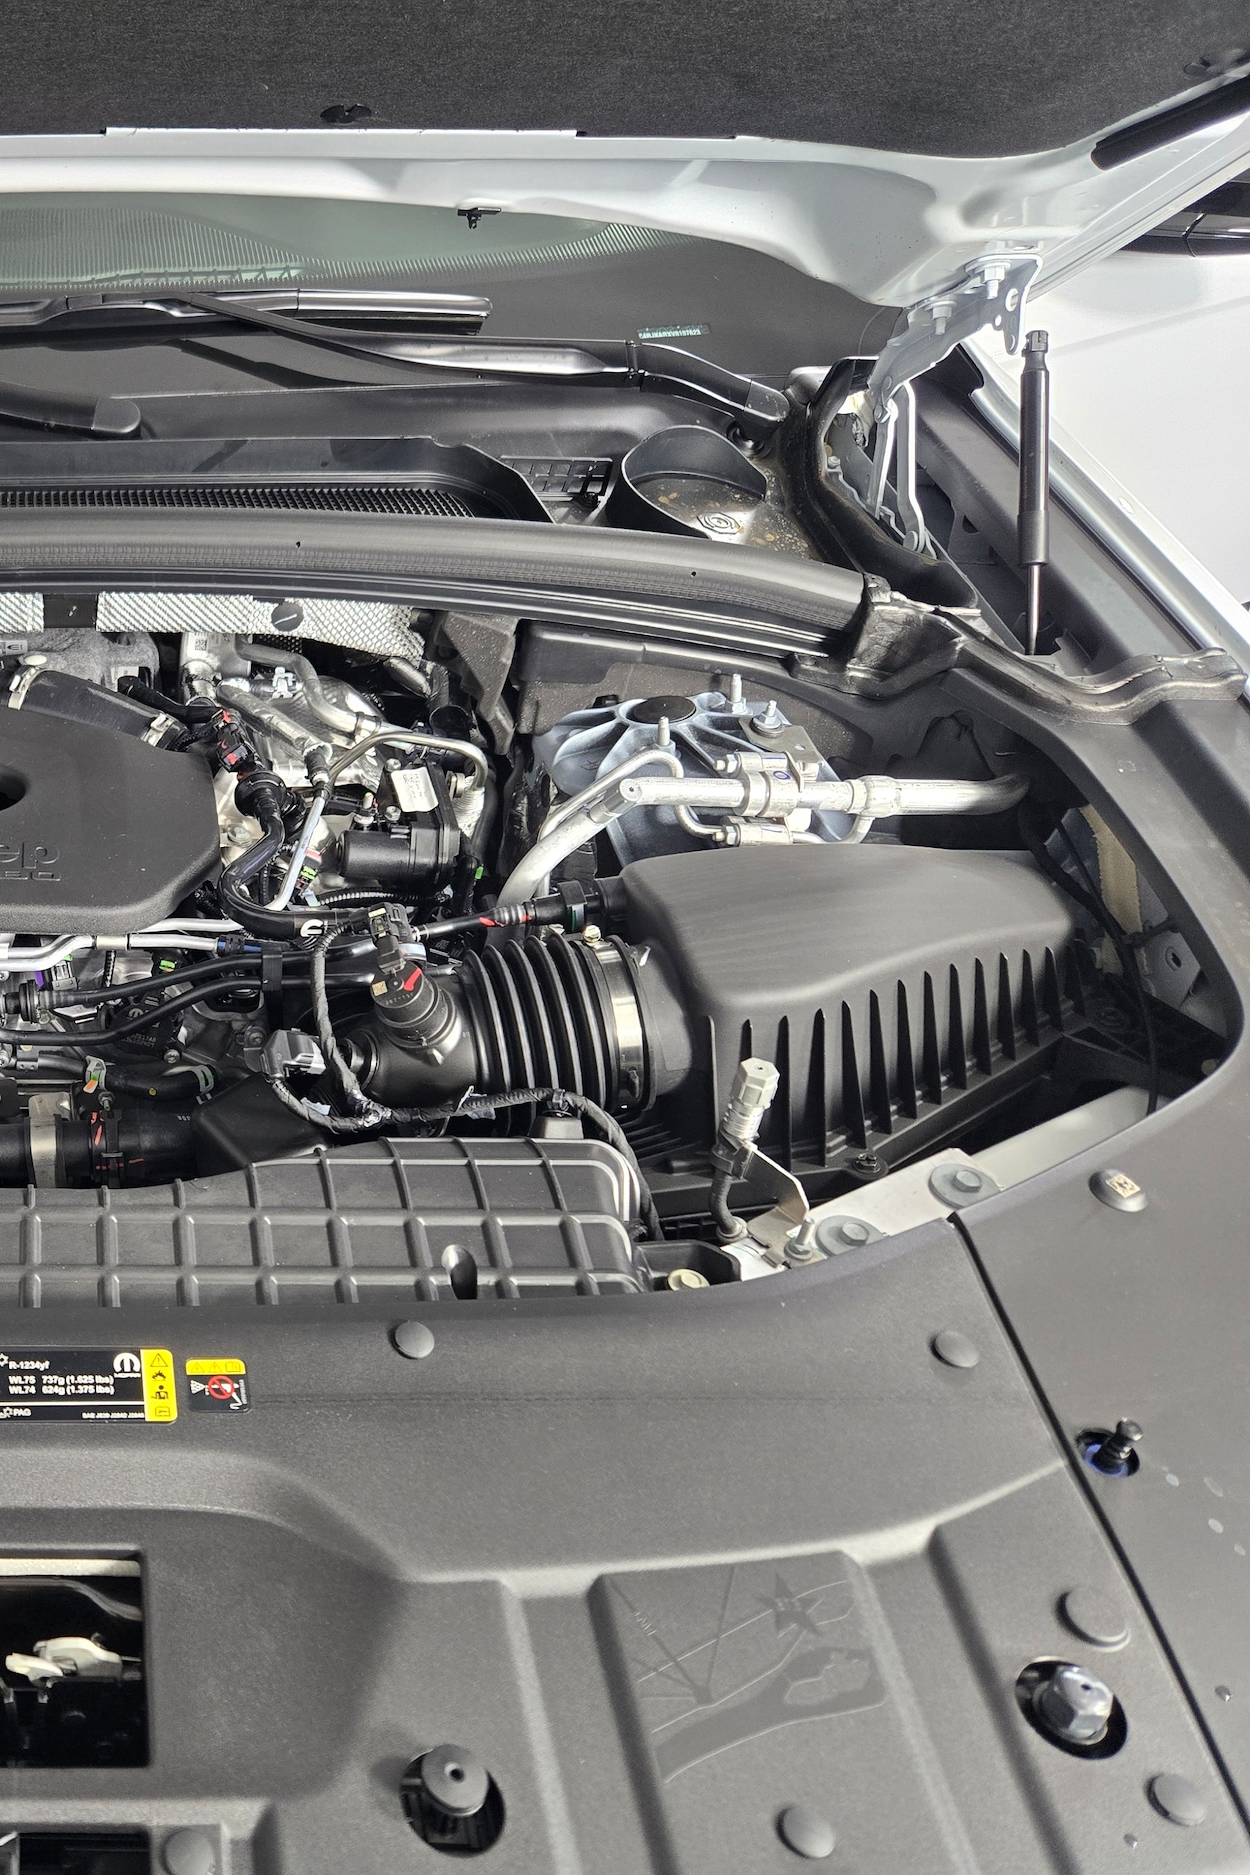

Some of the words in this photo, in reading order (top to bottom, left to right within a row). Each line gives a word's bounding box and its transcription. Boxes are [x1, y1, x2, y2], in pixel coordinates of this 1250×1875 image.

[8, 1360, 50, 1371] R-1234yf
[8, 1375, 36, 1385] WL75
[41, 1375, 65, 1386] 737g
[95, 1374, 114, 1386] lbs)
[8, 1385, 36, 1395] WL74
[41, 1385, 66, 1396] 624g
[95, 1385, 115, 1396] lbs)
[13, 1408, 32, 1416] PAG
